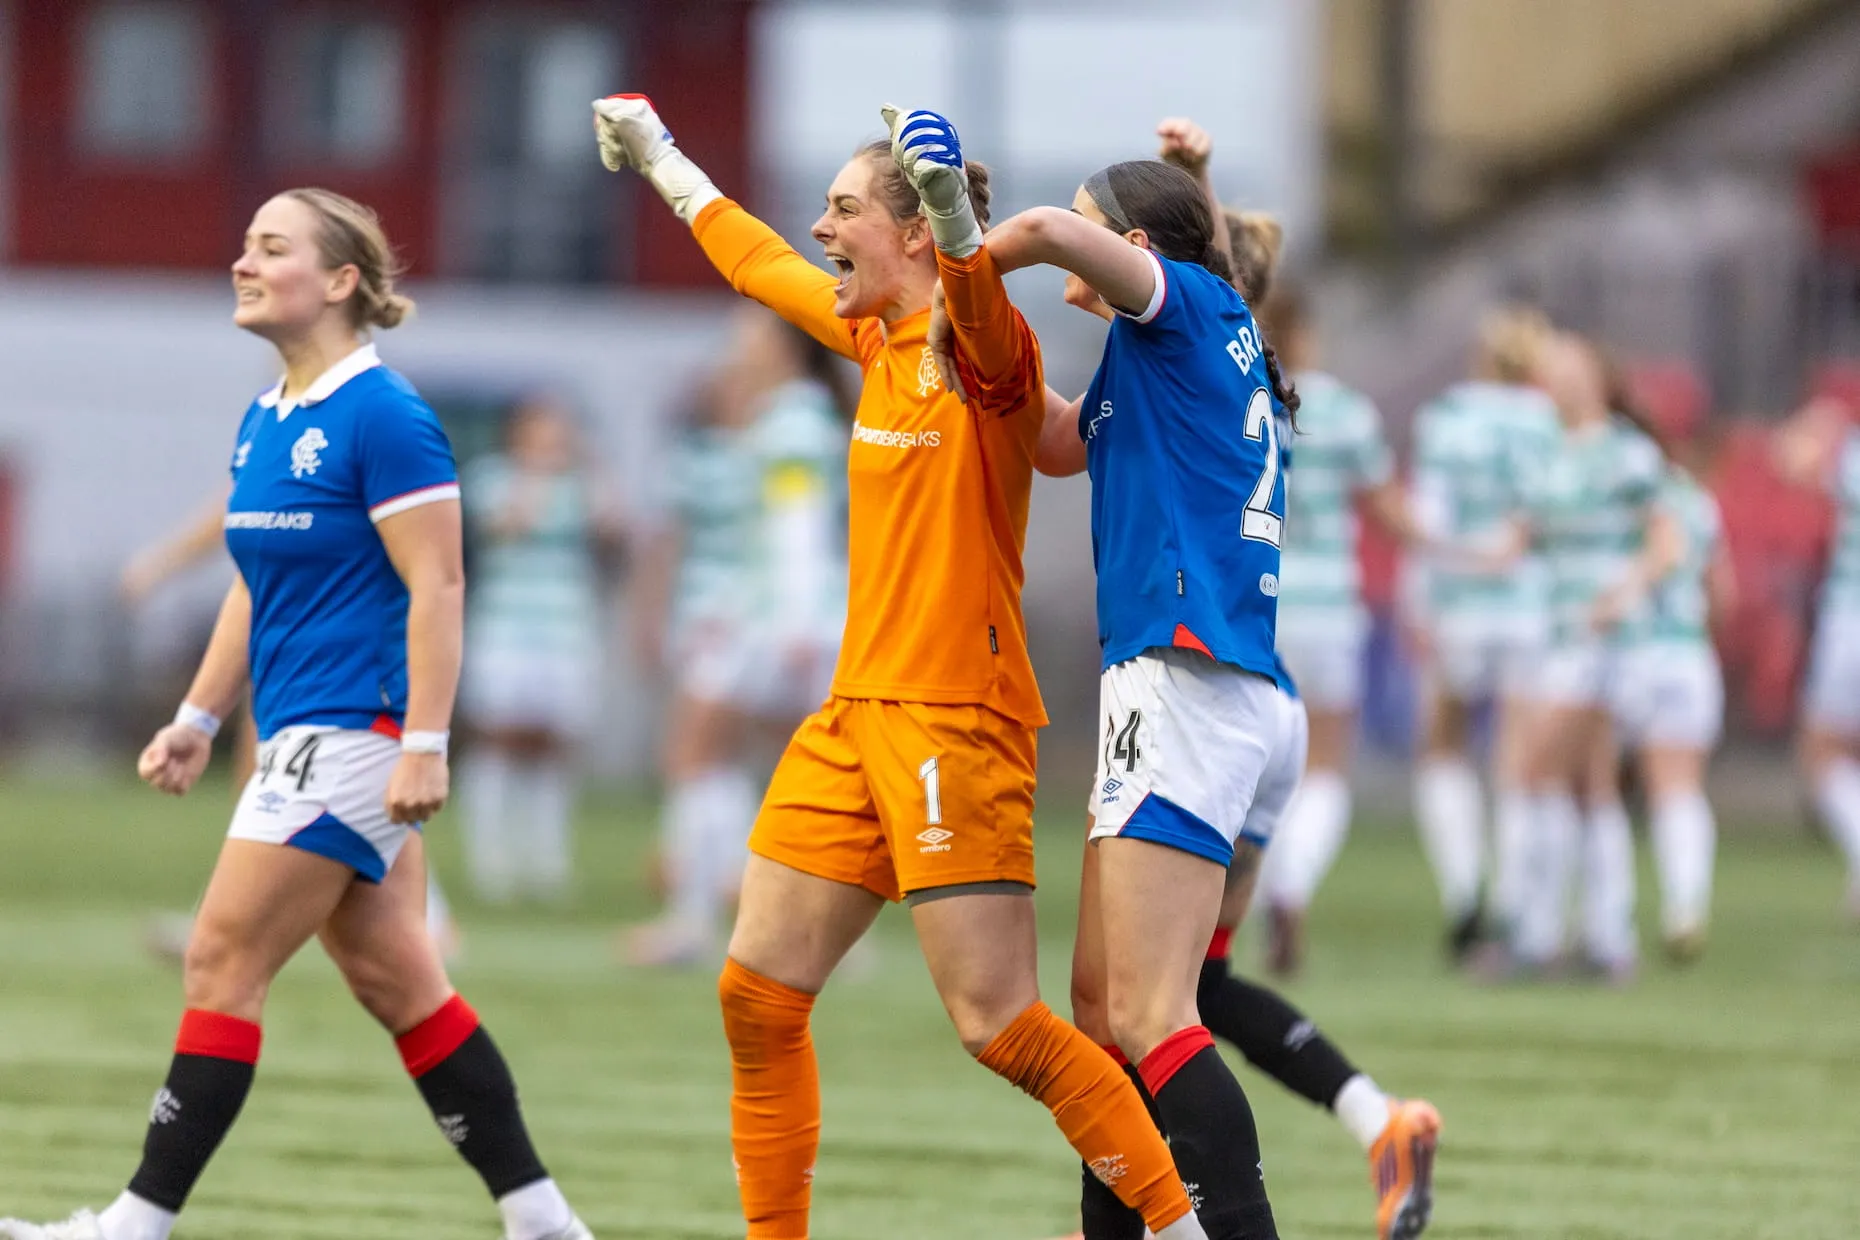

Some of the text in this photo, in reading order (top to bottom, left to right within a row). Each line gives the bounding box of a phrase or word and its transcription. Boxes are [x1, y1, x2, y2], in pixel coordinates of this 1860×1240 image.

[1241, 386, 1282, 550] 2
[919, 756, 942, 824] 1
[920, 844, 951, 853] umbro
